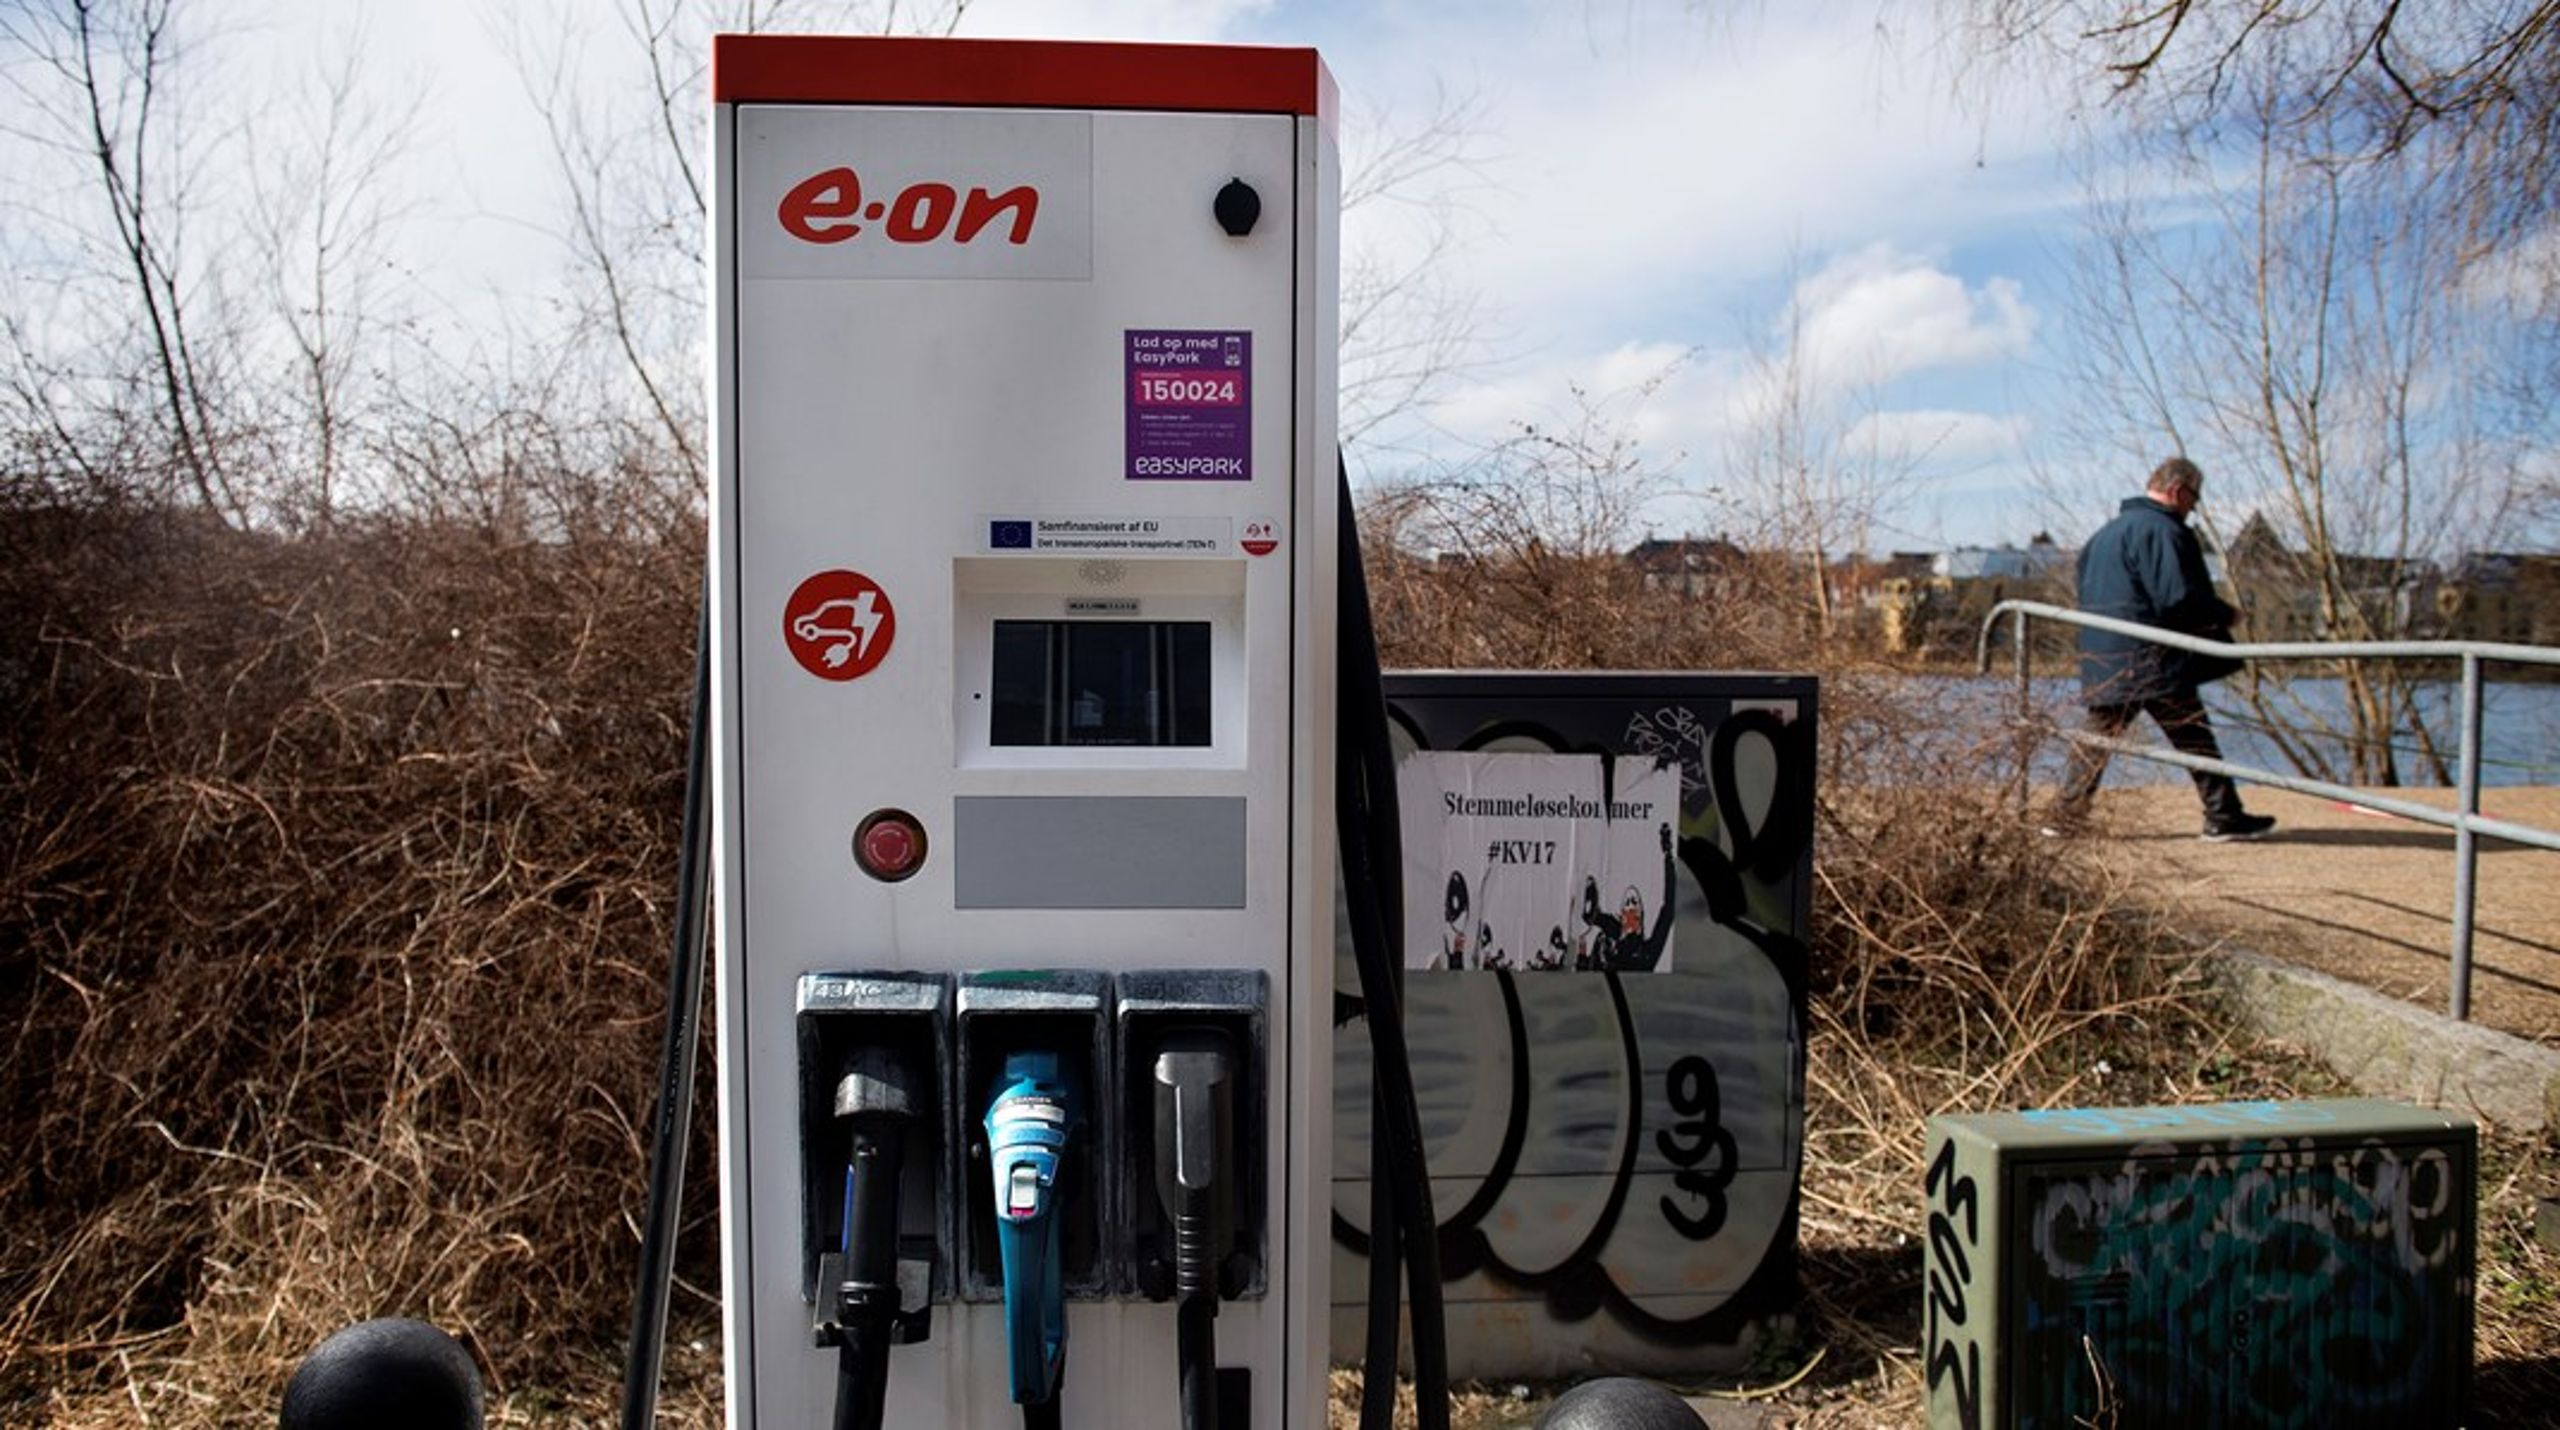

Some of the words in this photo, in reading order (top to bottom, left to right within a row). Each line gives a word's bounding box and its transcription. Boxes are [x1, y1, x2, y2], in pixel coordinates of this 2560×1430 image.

[1133, 336, 1159, 348] Lad
[1163, 339, 1183, 352] op
[1186, 336, 1219, 348] med
[1133, 351, 1200, 366] EasyPark
[1140, 380, 1236, 402] 150024
[1037, 520, 1126, 532] Samfinansieret
[1129, 521, 1140, 532] af
[1143, 521, 1159, 532] EU
[1487, 841, 1557, 864] #KV17
